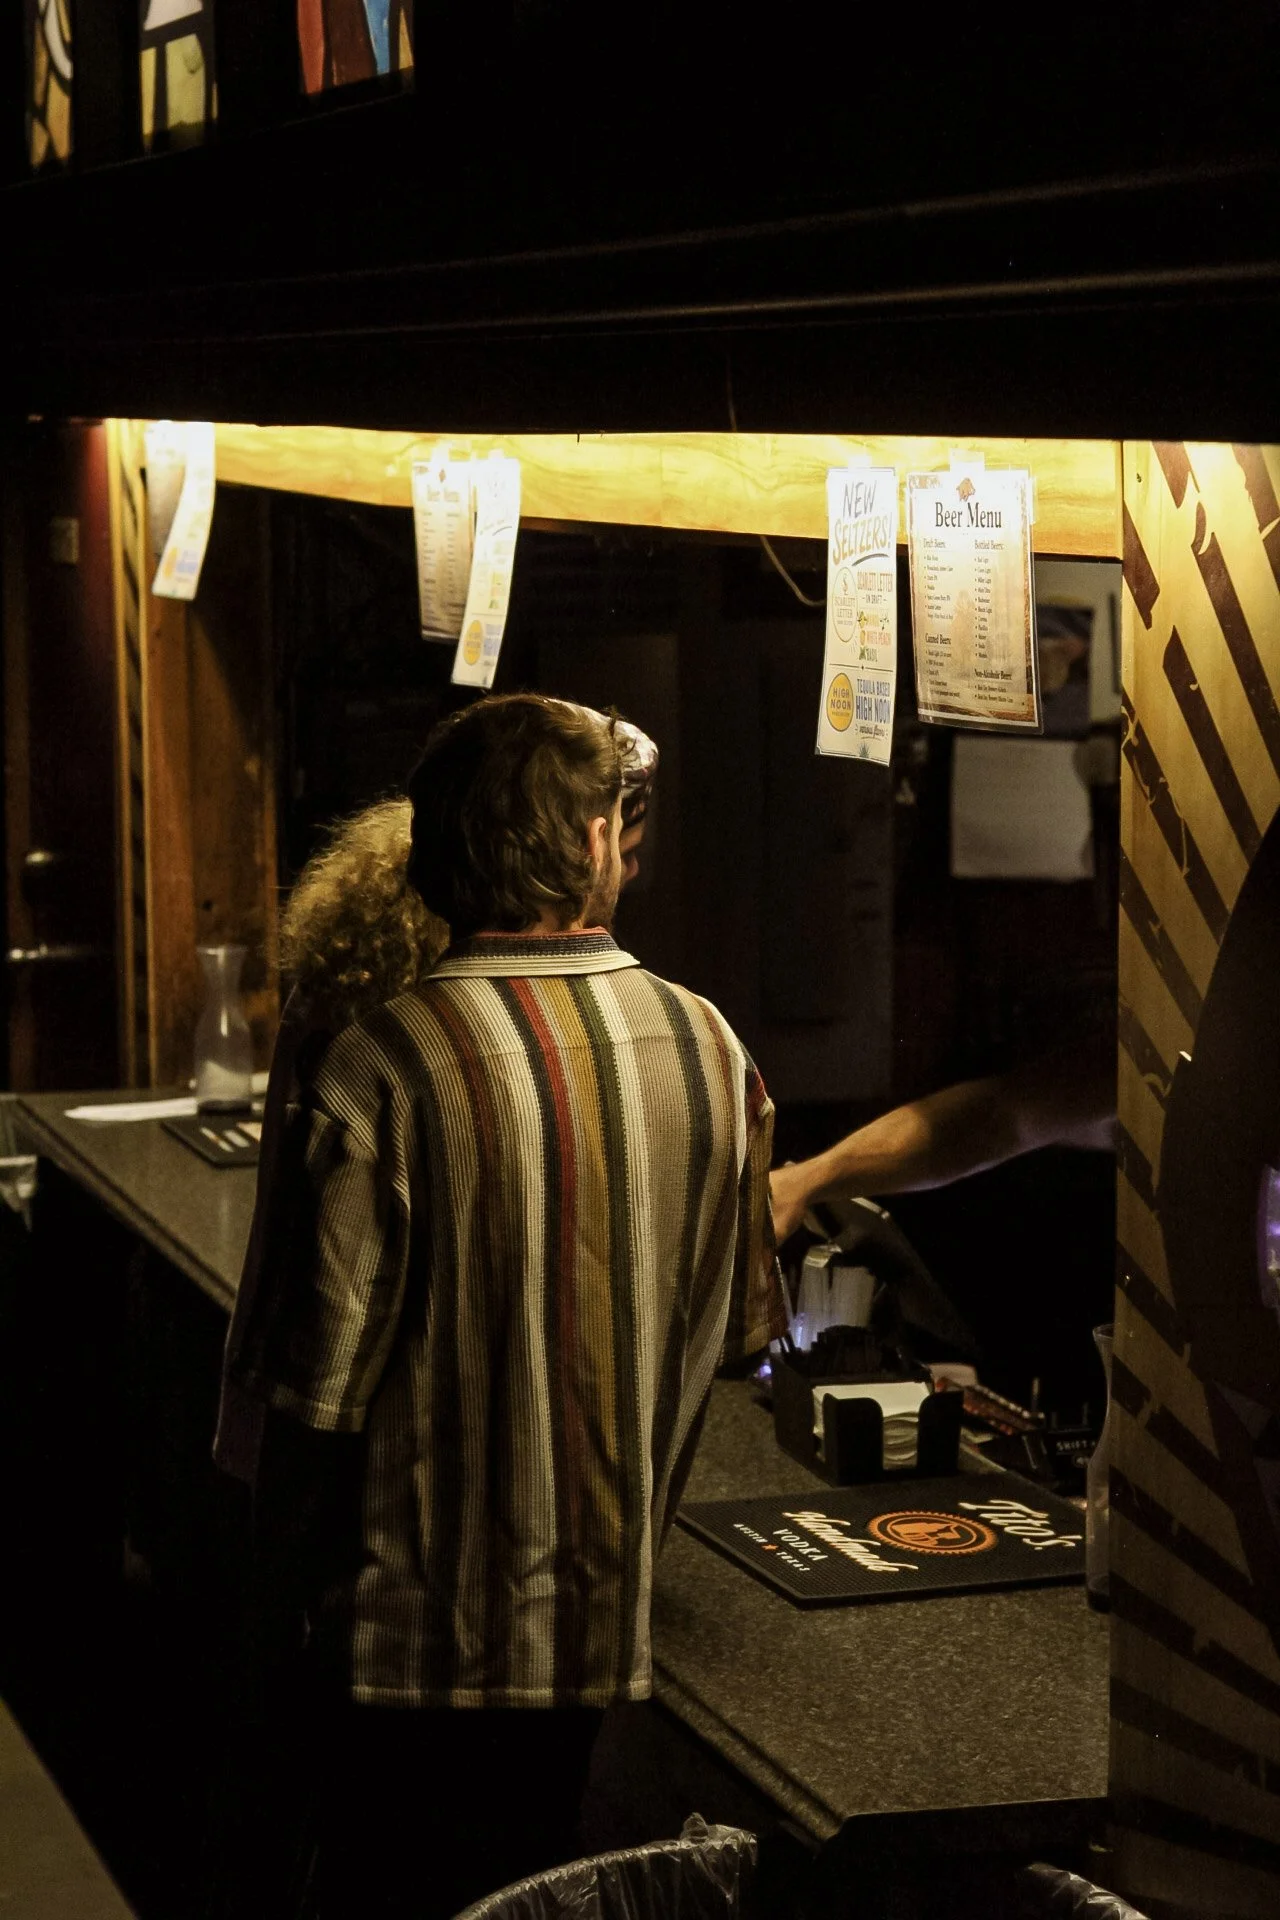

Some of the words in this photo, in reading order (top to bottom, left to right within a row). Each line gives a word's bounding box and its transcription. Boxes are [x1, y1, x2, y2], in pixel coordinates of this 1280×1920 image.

[843, 480, 877, 518] NEW
[935, 502, 963, 528] Beer
[967, 502, 1002, 528] Menu
[832, 511, 893, 565] SELTZERS!
[833, 687, 850, 699] HIGH
[857, 678, 876, 696] TEQUILA
[876, 681, 890, 697] BASED
[830, 699, 851, 711] NOON
[855, 695, 873, 721] HIGH
[874, 697, 891, 724] NOON
[958, 1499, 1083, 1549] Tito's
[733, 1523, 768, 1543] AUSTIN
[776, 1551, 811, 1572] TEXAS
[772, 1528, 829, 1561] VODKA
[782, 1511, 919, 1572] Handmade
